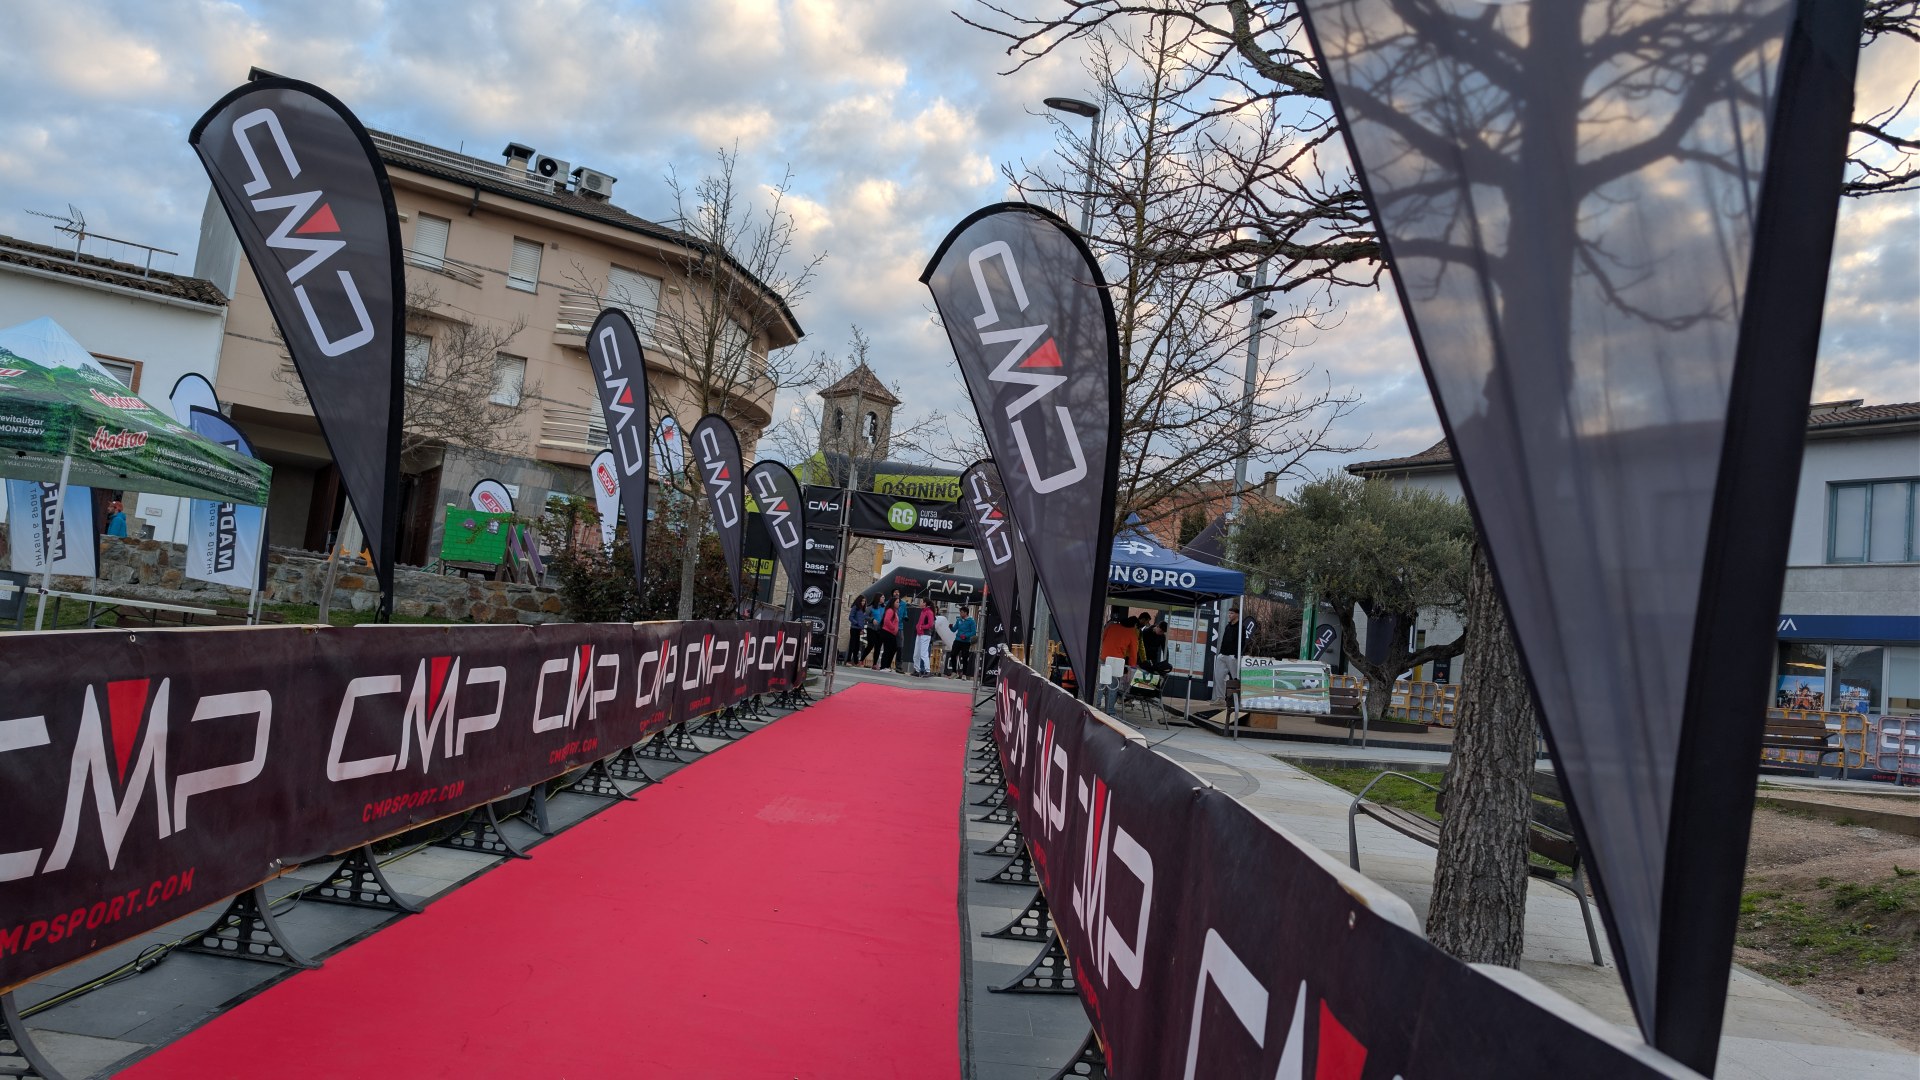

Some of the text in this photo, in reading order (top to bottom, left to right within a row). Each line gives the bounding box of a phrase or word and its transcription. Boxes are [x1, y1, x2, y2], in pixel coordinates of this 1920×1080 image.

[232, 108, 375, 357] CMP
[599, 326, 643, 476] CMP
[968, 240, 1088, 494] CMP
[700, 426, 739, 529] CMP
[755, 470, 800, 549] CMP
[808, 501, 839, 511] CMP
[920, 510, 938, 518] cursa
[891, 508, 913, 525] RG
[919, 518, 953, 531] rocgros
[970, 470, 1012, 565] CMP
[927, 579, 974, 595] CMP
[635, 640, 678, 708] CMP
[682, 634, 730, 690] CMP
[758, 631, 798, 672] CMP
[327, 656, 507, 782] CMP
[533, 645, 620, 734] CMP
[361, 779, 465, 823] CMPSPORT.COM
[0, 867, 195, 959] MPSPORT.COM
